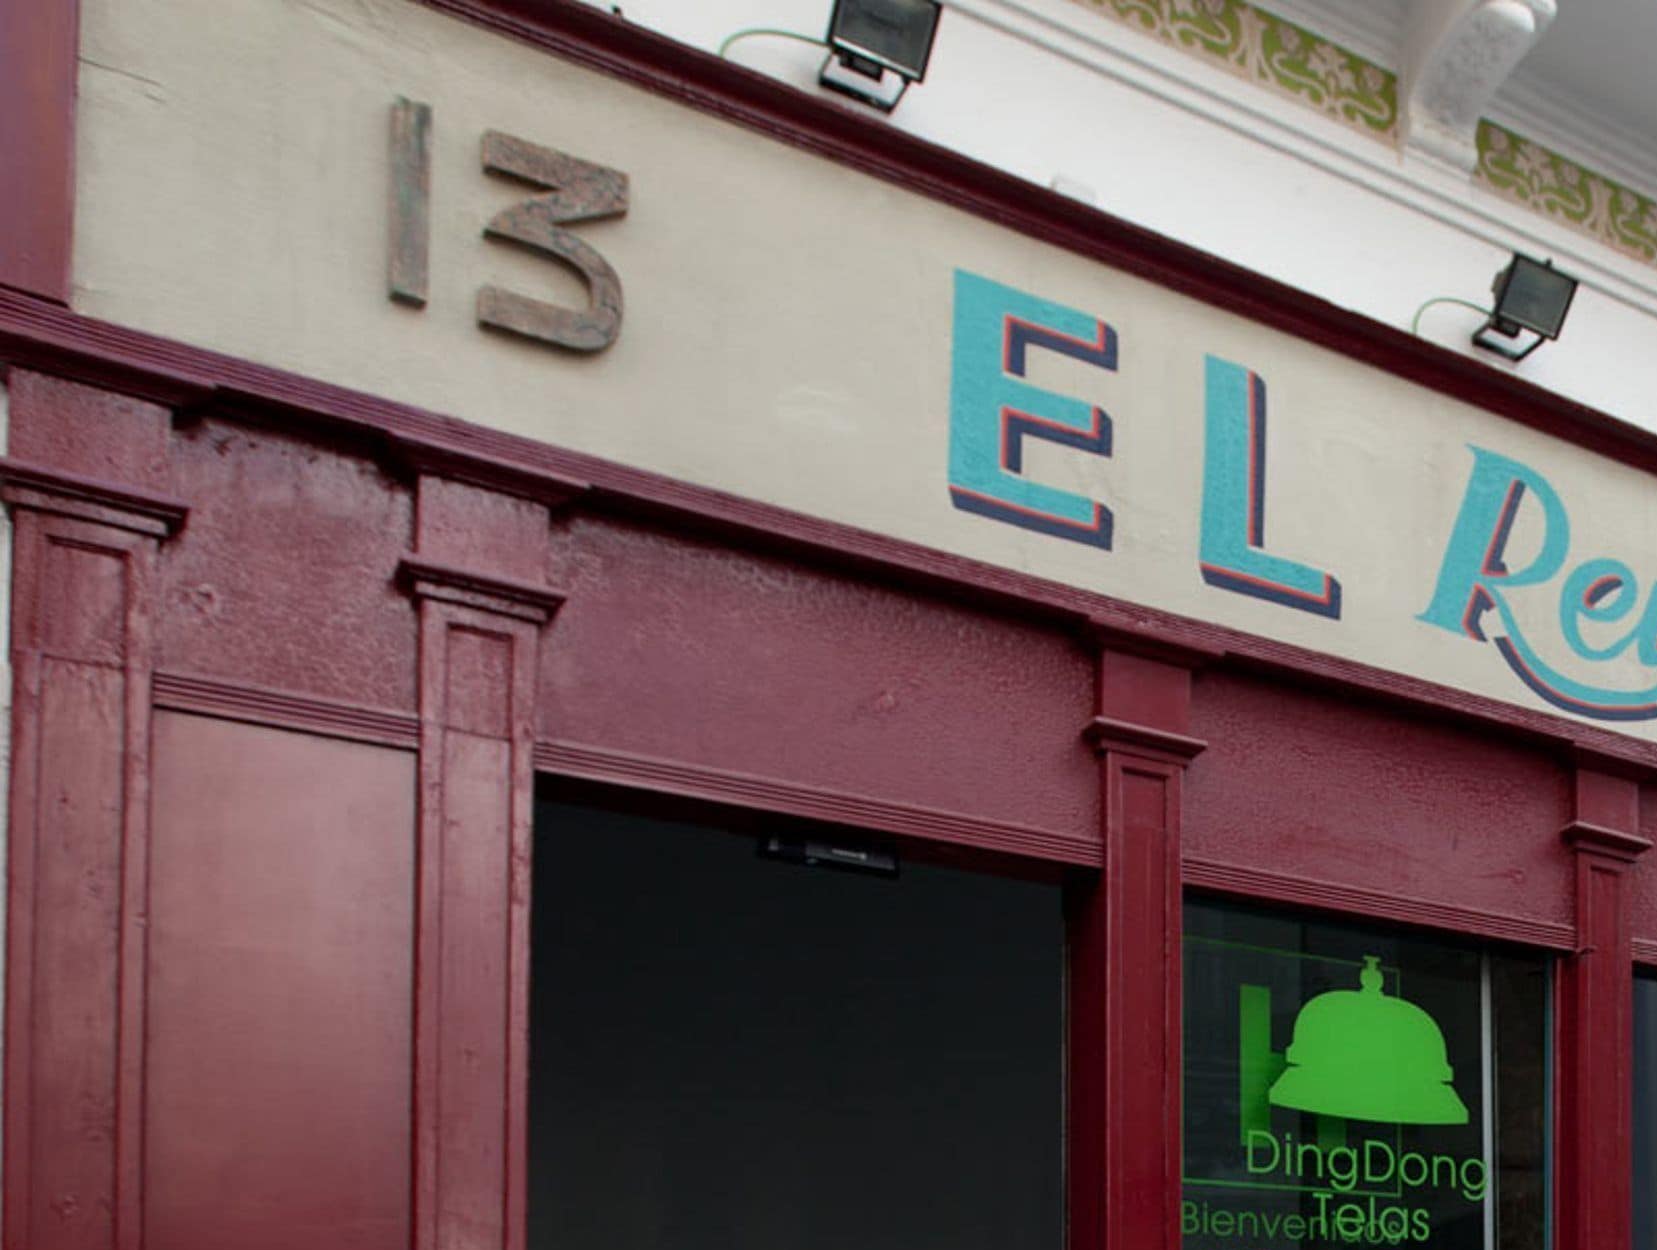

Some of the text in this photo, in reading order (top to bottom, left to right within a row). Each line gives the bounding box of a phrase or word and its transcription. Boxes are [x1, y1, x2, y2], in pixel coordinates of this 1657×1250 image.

[388, 97, 629, 354] 13
[948, 267, 1342, 620] EL
[1247, 1130, 1488, 1201] DingDong
[1312, 1192, 1431, 1242] Telas
